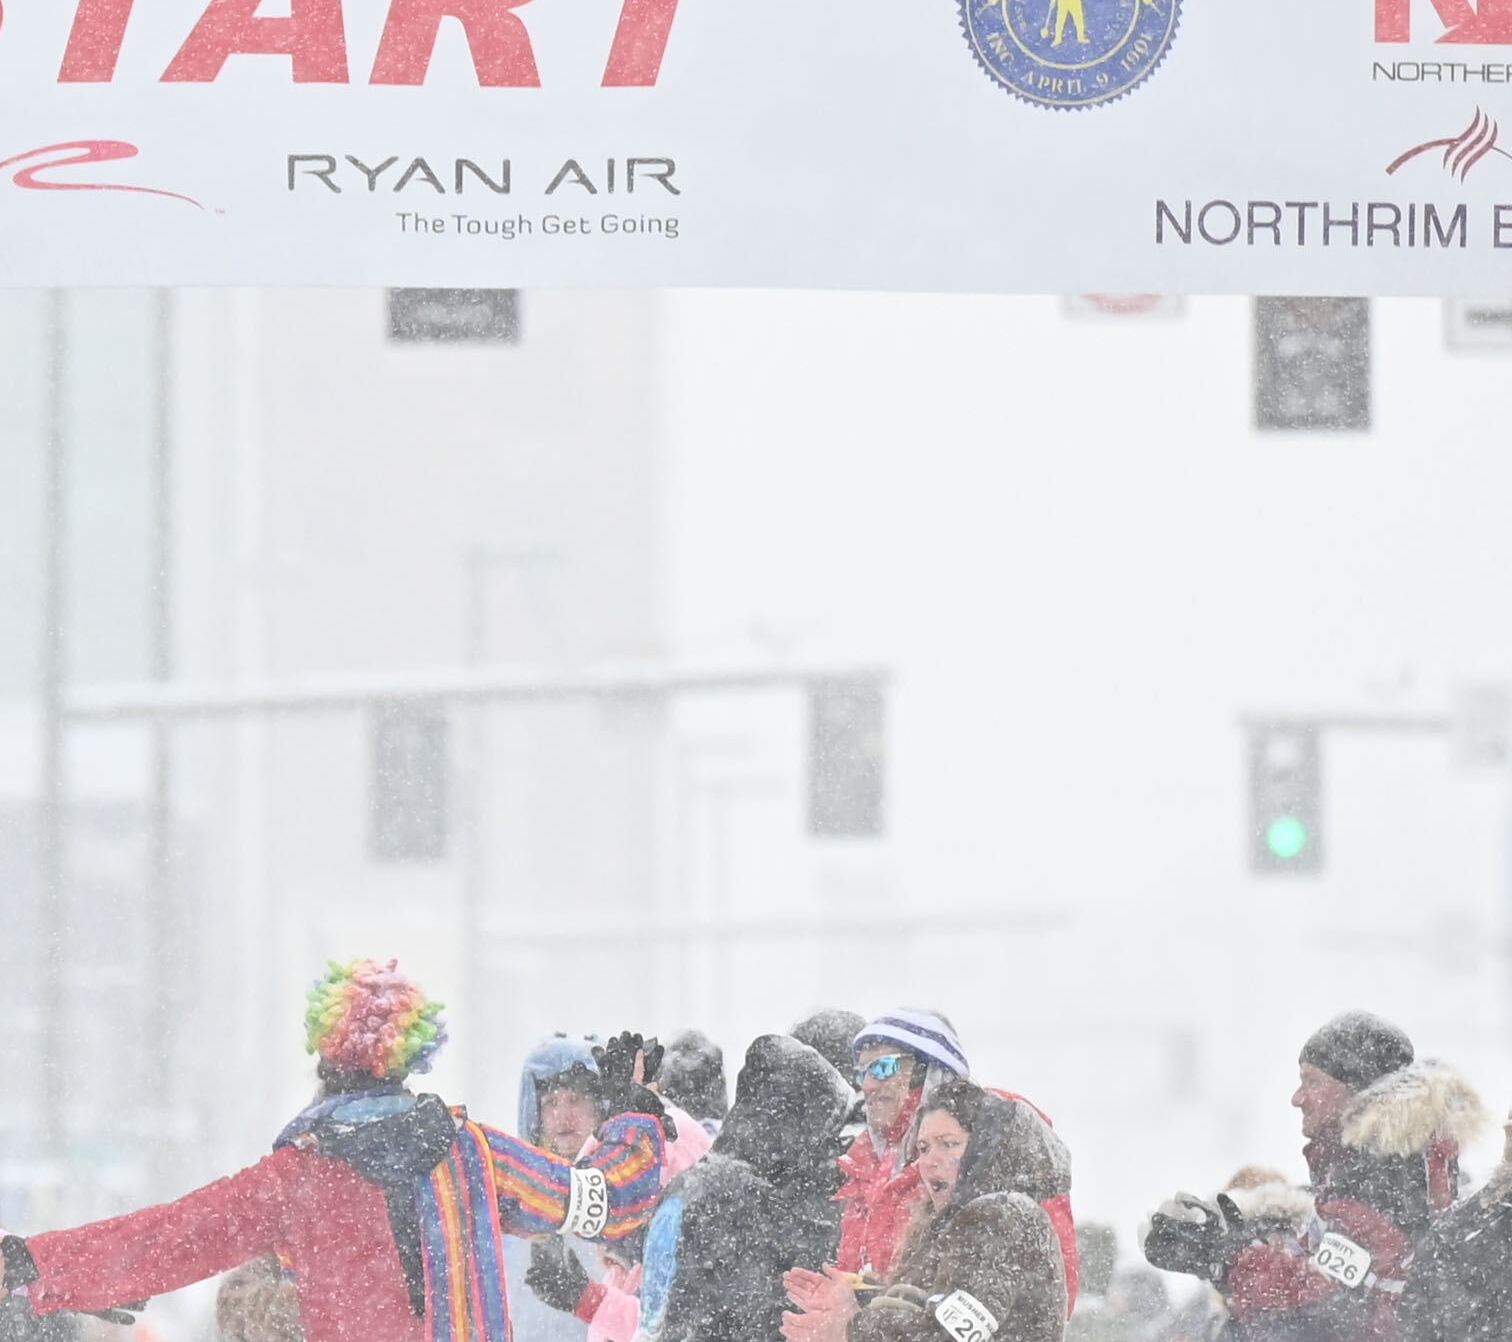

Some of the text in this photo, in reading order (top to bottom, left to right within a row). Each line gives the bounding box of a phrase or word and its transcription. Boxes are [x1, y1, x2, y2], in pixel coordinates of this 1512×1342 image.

[1022, 70, 1087, 94] APRIL
[1095, 72, 1110, 87] 9
[1120, 31, 1154, 72] 1901
[287, 154, 682, 196] RYAN AIR
[396, 212, 680, 242] The Tough Get Going
[1154, 199, 1468, 249] NORTHRIM
[581, 1174, 605, 1233] 2026
[1316, 1248, 1358, 1281] 026
[956, 1295, 986, 1323] MUSHER
